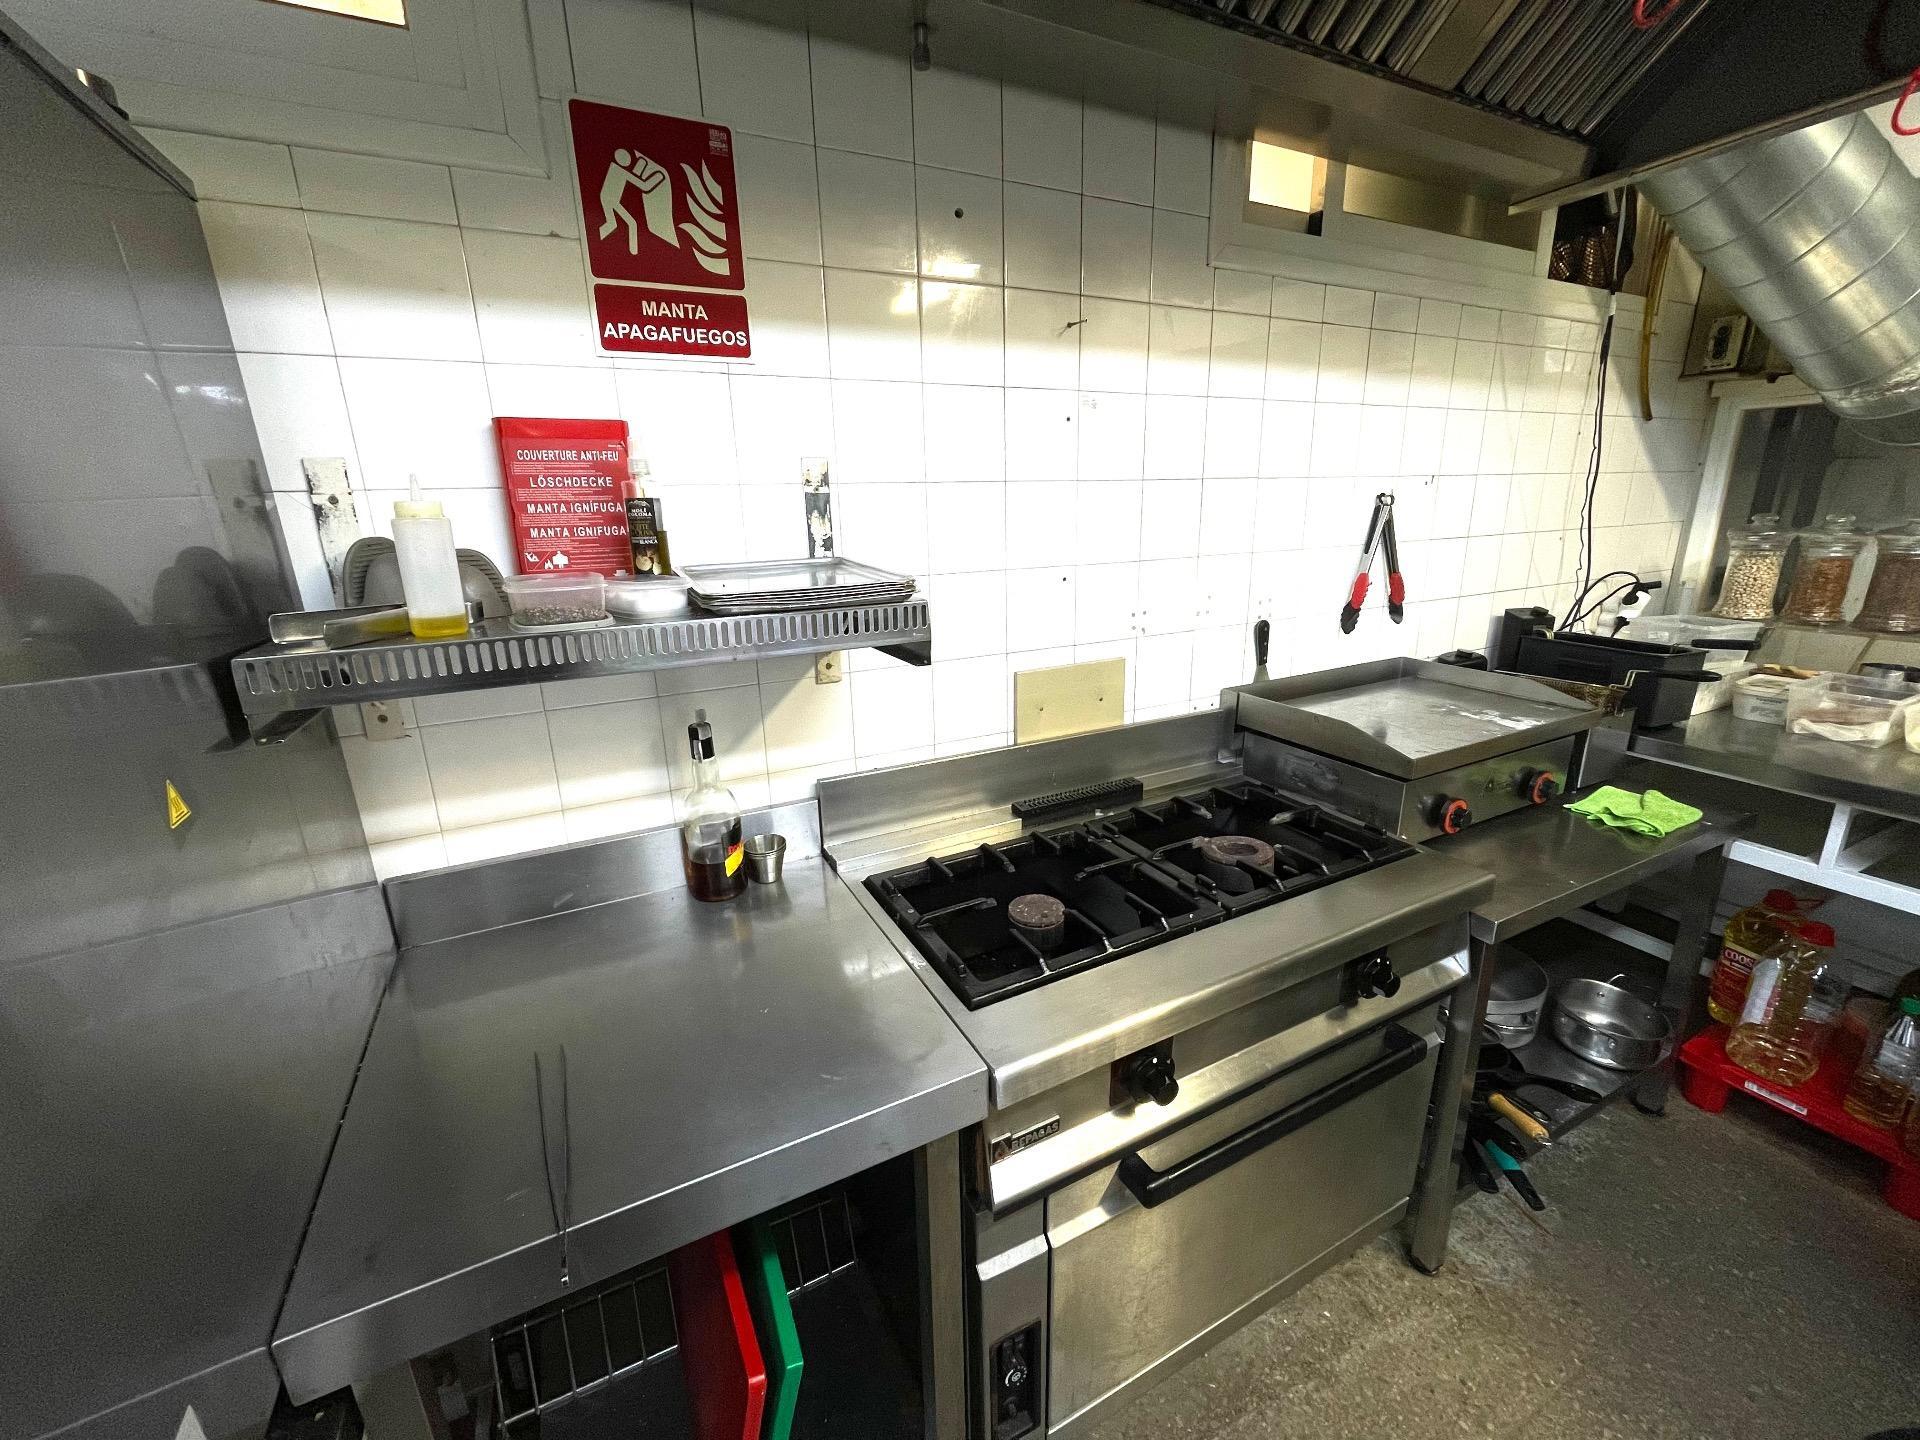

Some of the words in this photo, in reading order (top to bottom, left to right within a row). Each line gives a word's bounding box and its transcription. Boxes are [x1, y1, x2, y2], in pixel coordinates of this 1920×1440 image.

[642, 300, 708, 320] MANTA
[604, 323, 747, 347] APAGAFUEGOS
[517, 450, 578, 461] COUVERTURE
[581, 451, 618, 461] ANTI-FEU
[529, 475, 613, 487] LÖSCHDECKE
[526, 503, 567, 514] MANTA
[571, 501, 623, 513] IGNÍFUGA
[530, 527, 570, 538] MANTA
[574, 526, 626, 537] IGNIFUGA
[1011, 1122, 1059, 1150] REPAGAS
